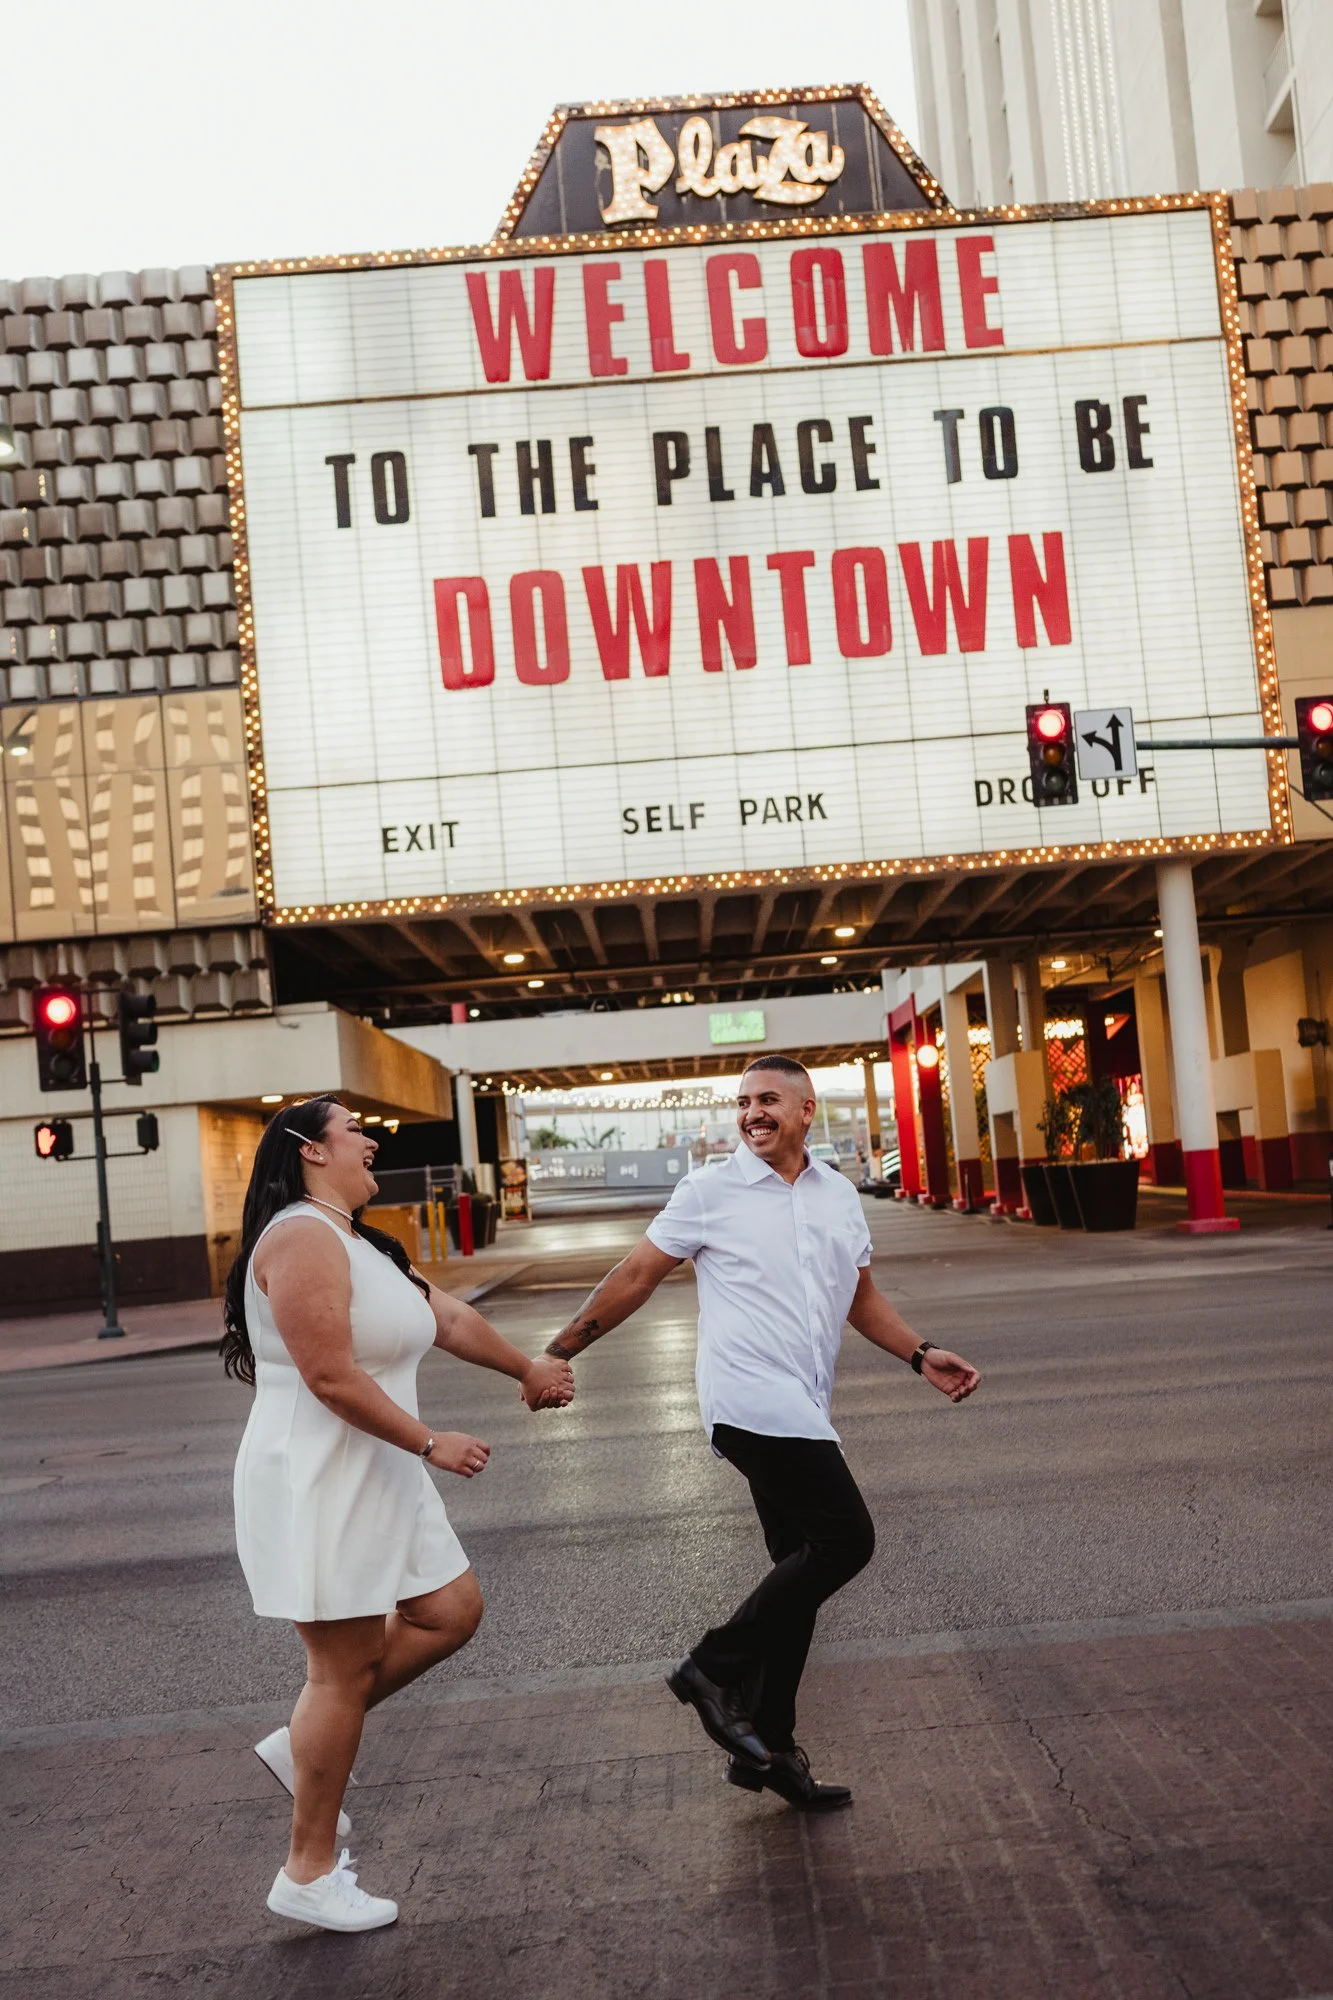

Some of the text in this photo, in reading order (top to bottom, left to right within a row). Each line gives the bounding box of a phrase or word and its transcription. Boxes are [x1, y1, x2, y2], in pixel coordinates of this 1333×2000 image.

[594, 116, 845, 224] Plaza
[466, 235, 1004, 384] WELCOME
[325, 394, 1154, 529] TO THE PLACE TO BE
[434, 531, 1072, 691] DOWNTOWN
[382, 821, 460, 853] EXIT
[622, 793, 828, 834] SELF PARK
[974, 775, 1036, 807] DRO
